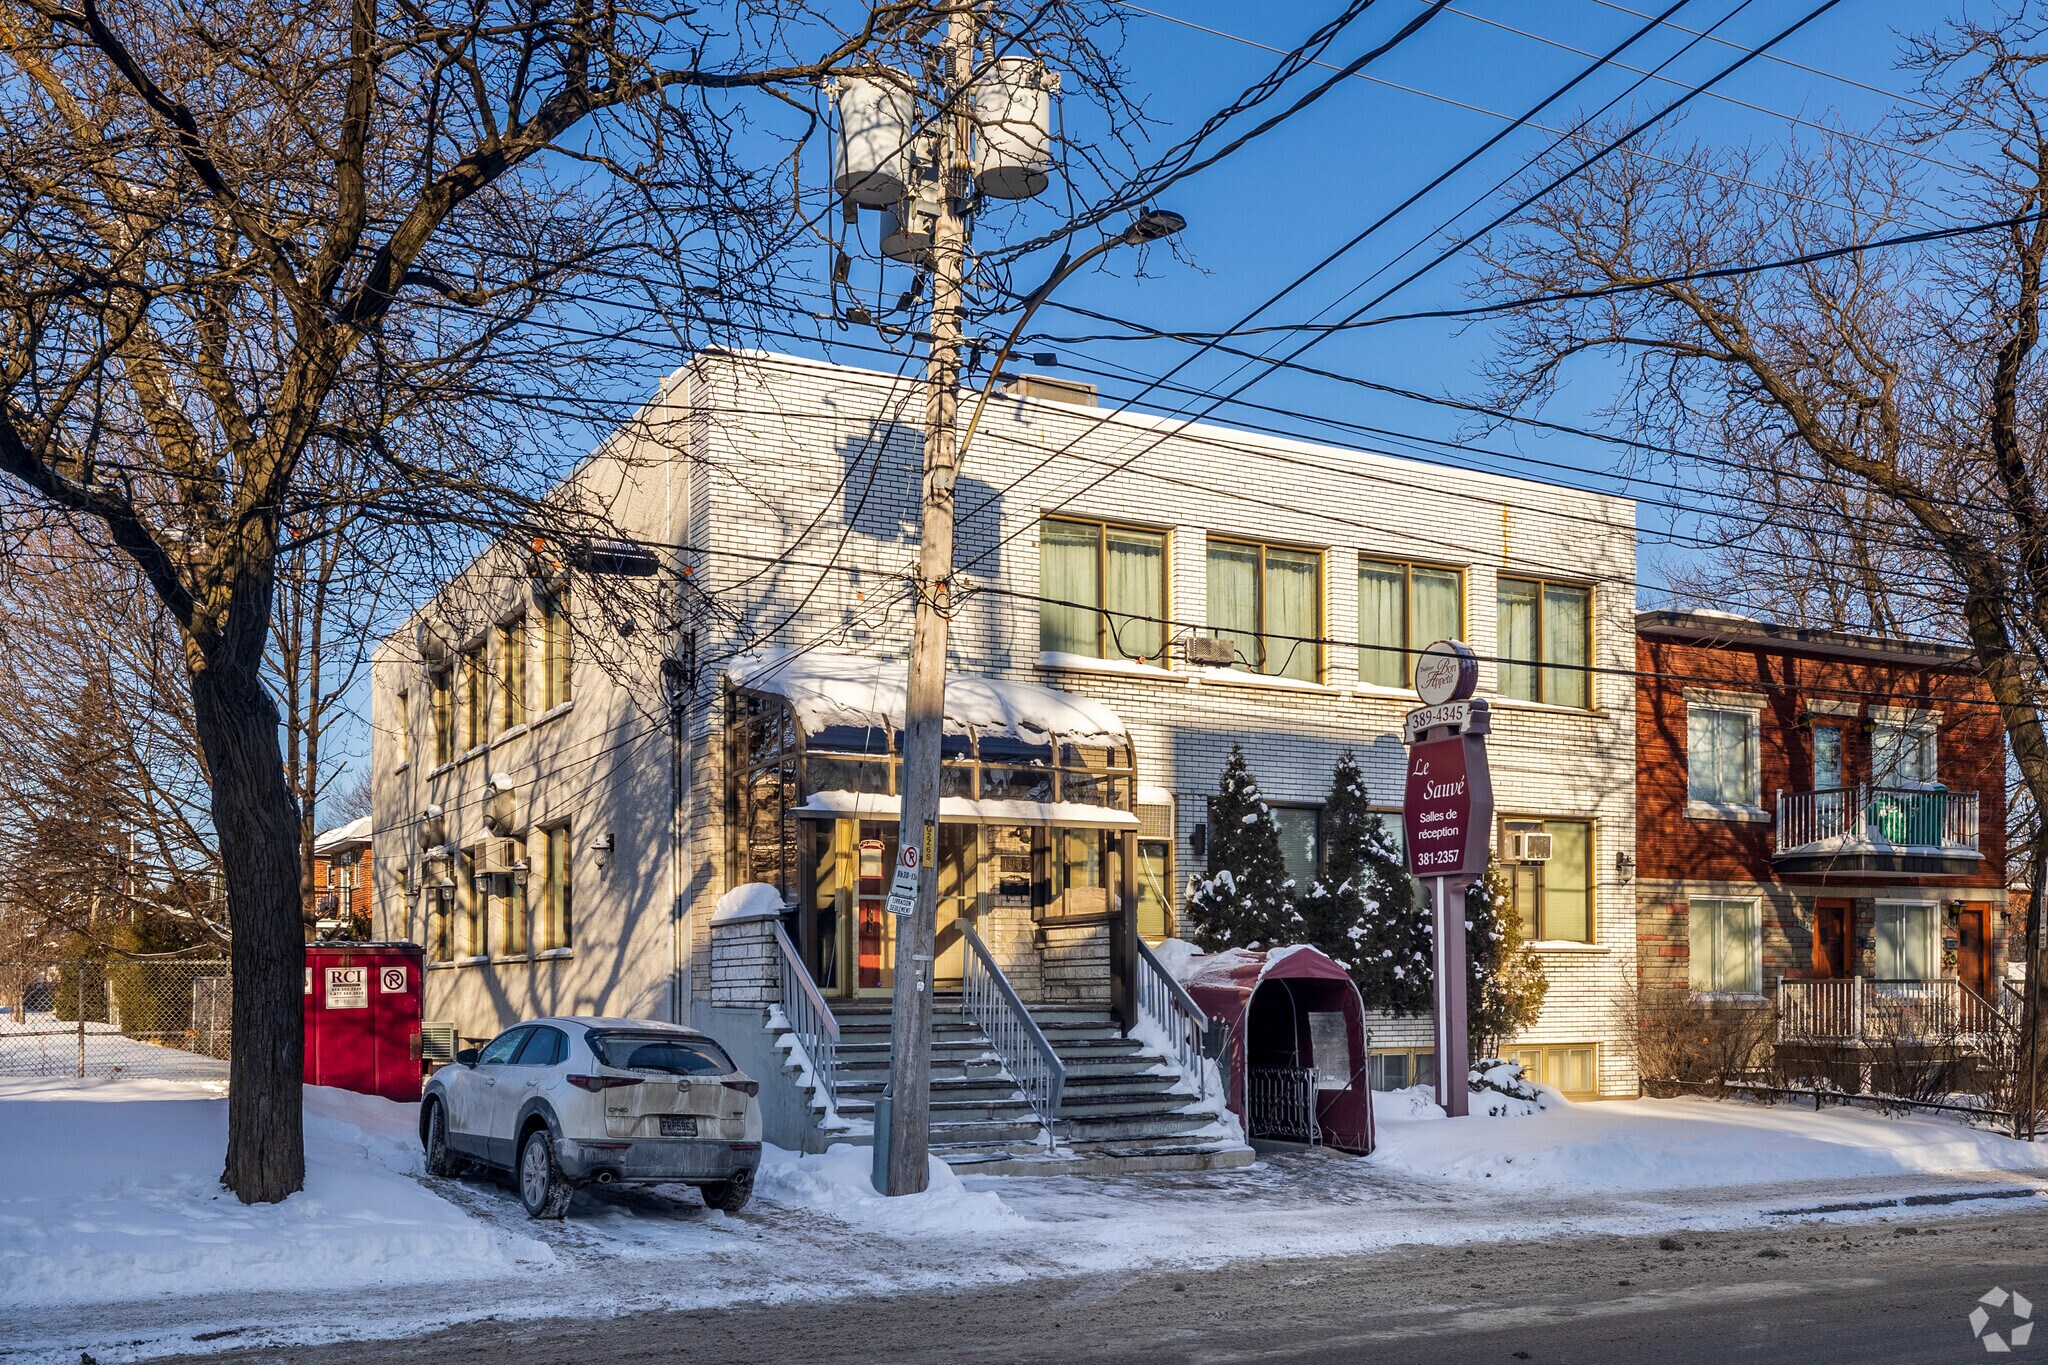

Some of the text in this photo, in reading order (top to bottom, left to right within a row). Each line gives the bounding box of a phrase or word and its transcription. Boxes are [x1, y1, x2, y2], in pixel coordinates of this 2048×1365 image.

[1437, 657, 1457, 676] Bon
[1420, 670, 1454, 690] Appétit
[1412, 705, 1463, 730] 389-4345
[1412, 758, 1430, 777] Le
[1423, 774, 1465, 800] Sauvé
[1419, 808, 1458, 824] Salles de
[1418, 826, 1459, 840] réception
[1417, 848, 1460, 867] 381-2357
[331, 970, 362, 984] RCI
